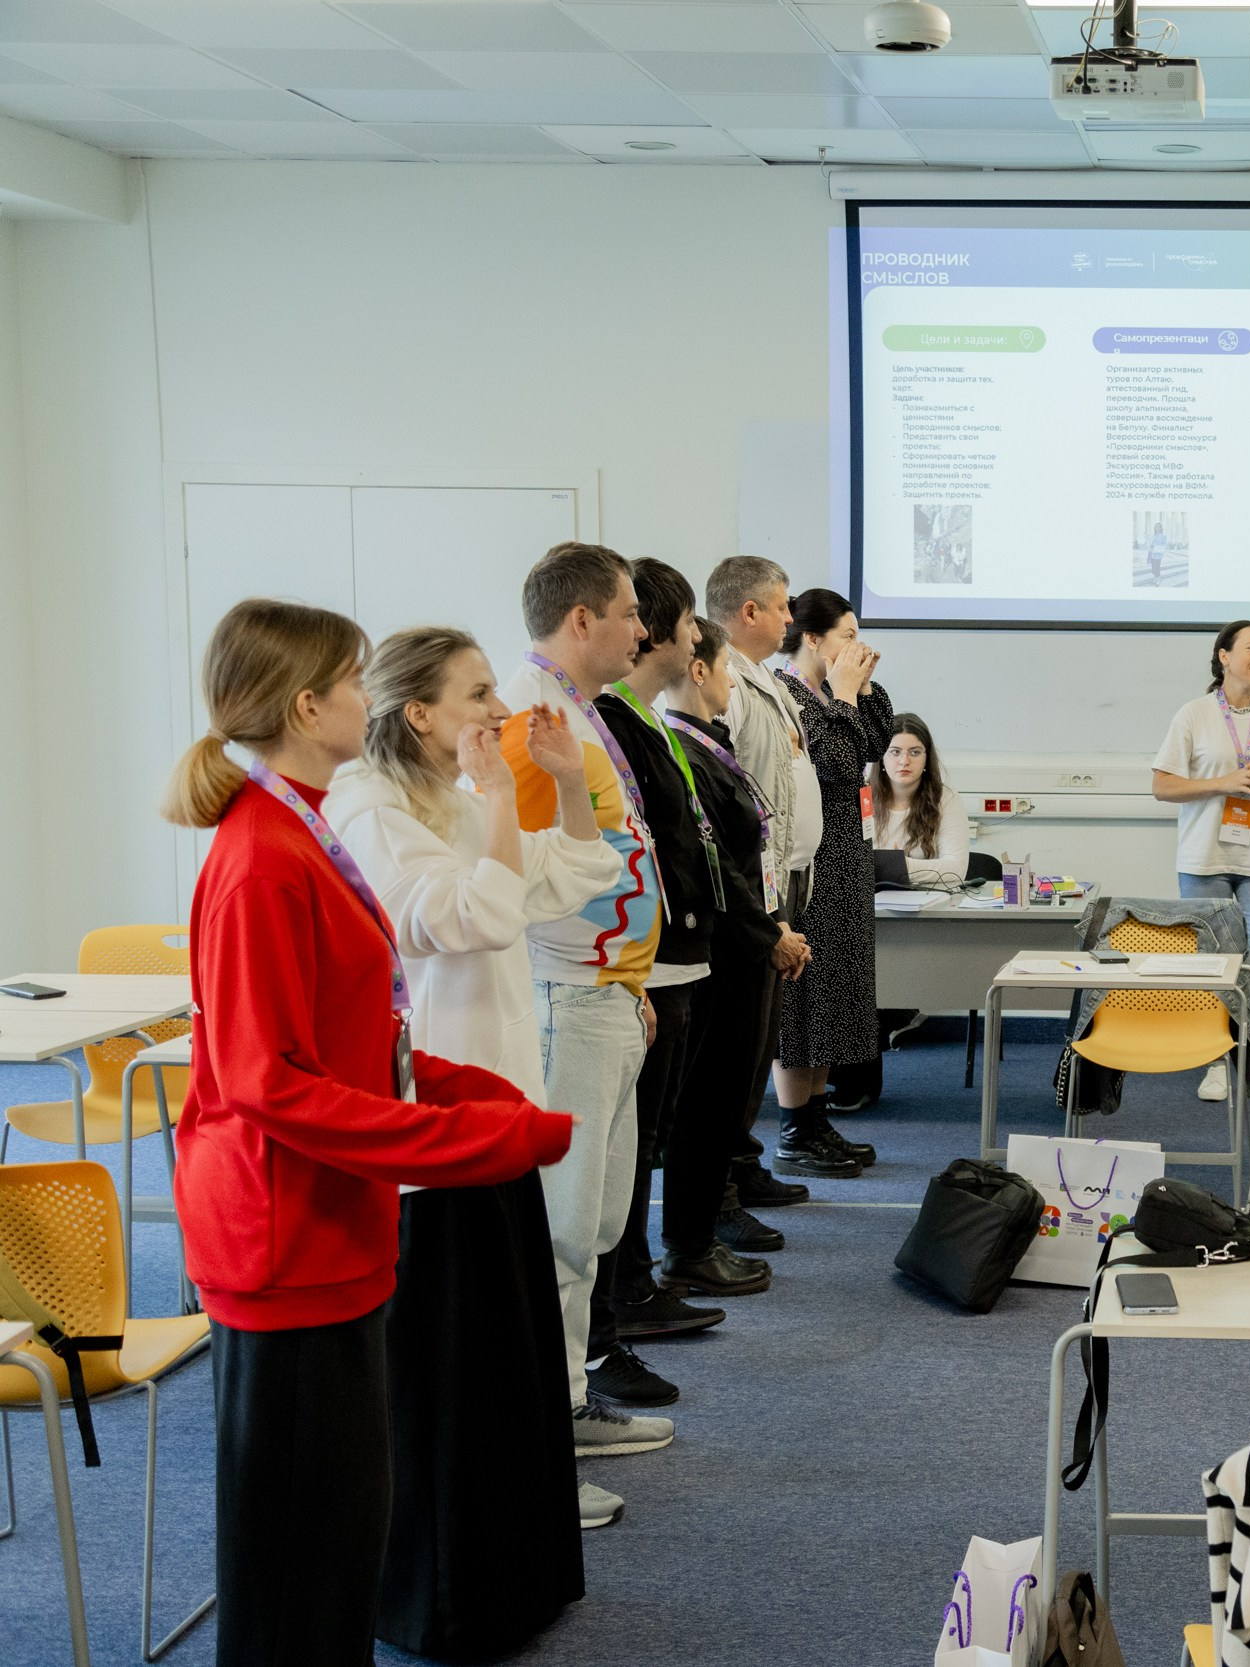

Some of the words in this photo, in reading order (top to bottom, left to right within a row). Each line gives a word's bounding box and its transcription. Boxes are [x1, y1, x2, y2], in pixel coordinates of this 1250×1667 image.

[862, 252, 970, 268] ПРОВОДНИК
[862, 271, 949, 284] СМЫСЛОВ
[921, 334, 950, 346] Цели
[953, 336, 960, 344] и
[964, 336, 1008, 346] задачи:
[1113, 333, 1209, 344] Самопрезентаци
[892, 365, 914, 373] Цель
[915, 366, 965, 374] участников:
[1106, 365, 1161, 374] Организатор
[1163, 366, 1203, 374] активных
[892, 375, 937, 383] доработка
[1145, 375, 1174, 384] Алтаю,
[1106, 395, 1159, 403] переводчик.
[1162, 395, 1196, 403] Прошла
[1135, 405, 1188, 413] альпинизма,
[1106, 414, 1154, 422] совершила
[1119, 424, 1149, 432] Белуху.
[902, 433, 957, 441] Представить
[1106, 433, 1175, 441] Всероссийского
[902, 452, 965, 460] Сформировать
[1106, 452, 1139, 460] первый
[1106, 462, 1160, 470] Экскурсовод
[902, 471, 959, 479] направлений
[1176, 472, 1215, 480] работала
[902, 481, 947, 489] доработке
[1134, 491, 1165, 499] службе
[1168, 492, 1214, 500] протокола.
